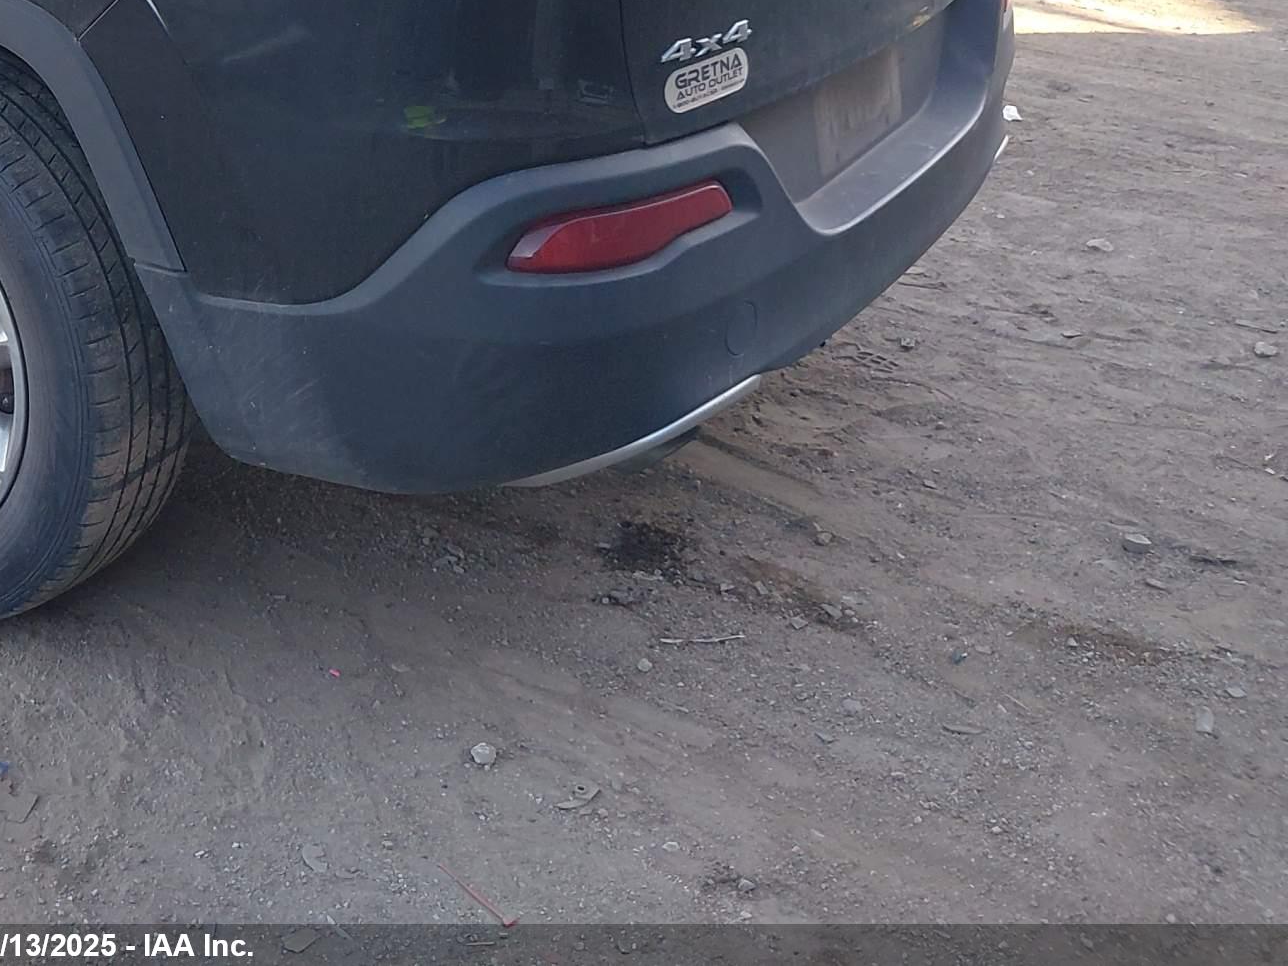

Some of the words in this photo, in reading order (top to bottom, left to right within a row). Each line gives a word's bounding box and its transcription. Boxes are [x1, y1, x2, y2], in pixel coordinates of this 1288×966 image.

[660, 19, 753, 63] 4x4
[675, 53, 742, 90] GRETNA
[676, 82, 706, 101] AUTO
[708, 67, 743, 88] OUTLET
